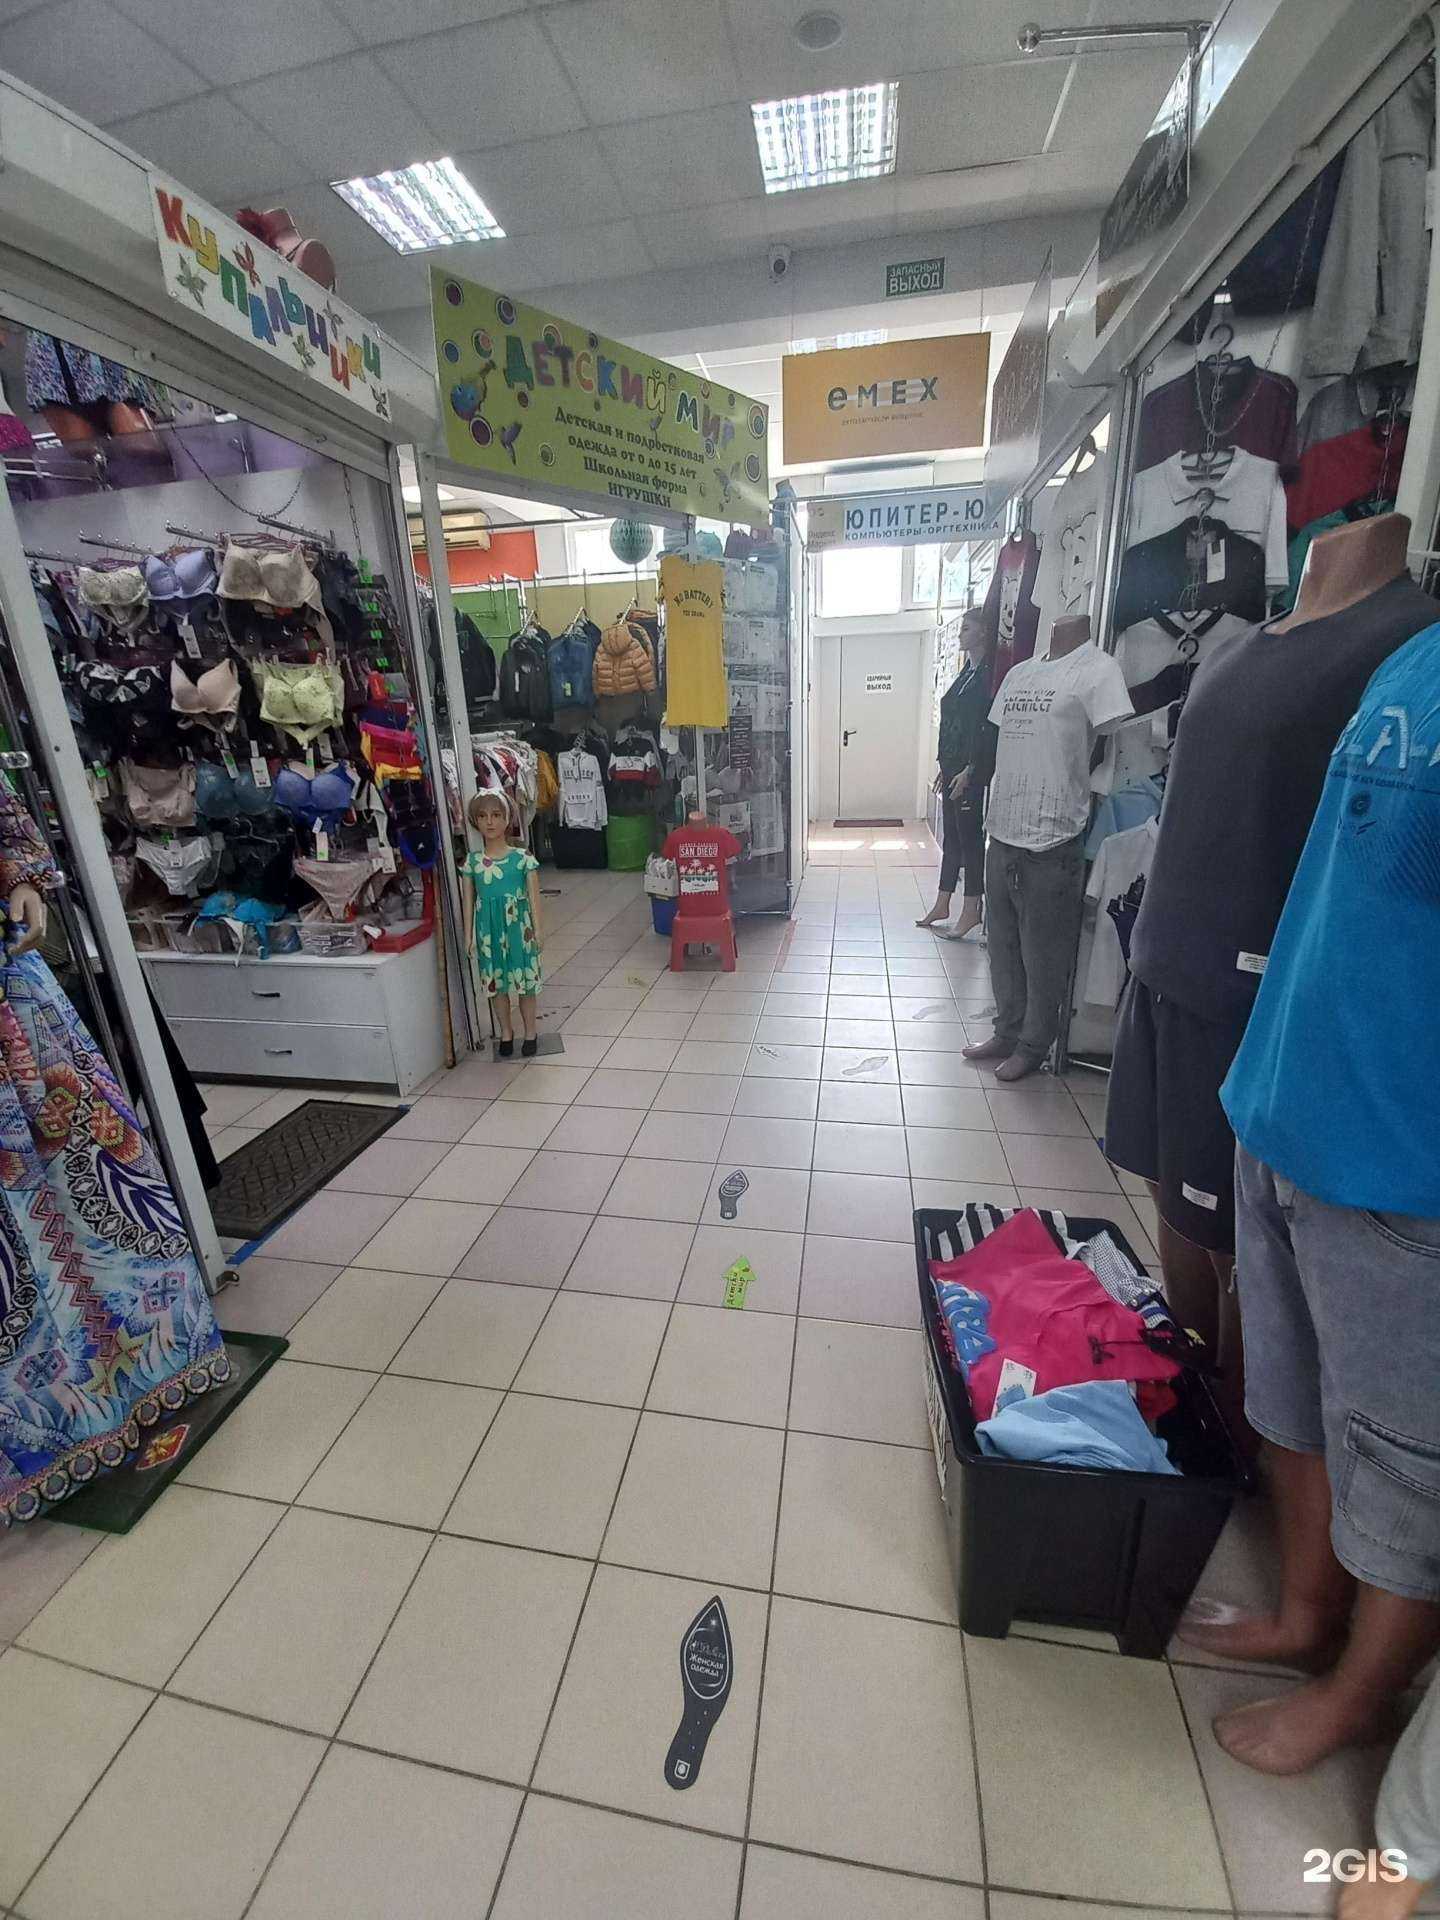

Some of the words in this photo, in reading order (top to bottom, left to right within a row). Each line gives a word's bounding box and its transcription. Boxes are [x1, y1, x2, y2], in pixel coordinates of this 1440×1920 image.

[889, 262, 941, 278] ЗАПАСНЫЙ
[889, 272, 941, 294] ВЫХОД
[503, 334, 667, 415] ДЕТСКИЙ
[676, 390, 736, 450] МИР
[555, 406, 612, 438] Детская
[615, 427, 624, 439] и
[626, 430, 705, 465] подростковая
[568, 435, 618, 458] одежда
[620, 450, 636, 463] от
[648, 457, 661, 470] до
[664, 461, 677, 476] 15
[679, 467, 697, 480] лет
[583, 456, 650, 486] Школьная
[652, 477, 688, 496] форма
[608, 482, 672, 509] ИГРУШКИ
[845, 498, 985, 531] ЮПИТЕР-Ю
[845, 522, 1000, 541] КОМПЬЮТЕРЫ-ОРГТЕХНИА
[680, 847, 695, 857] SAN
[696, 847, 718, 857] DIEGO
[689, 1652, 724, 1670] Женская
[690, 1663, 720, 1677] одежда
